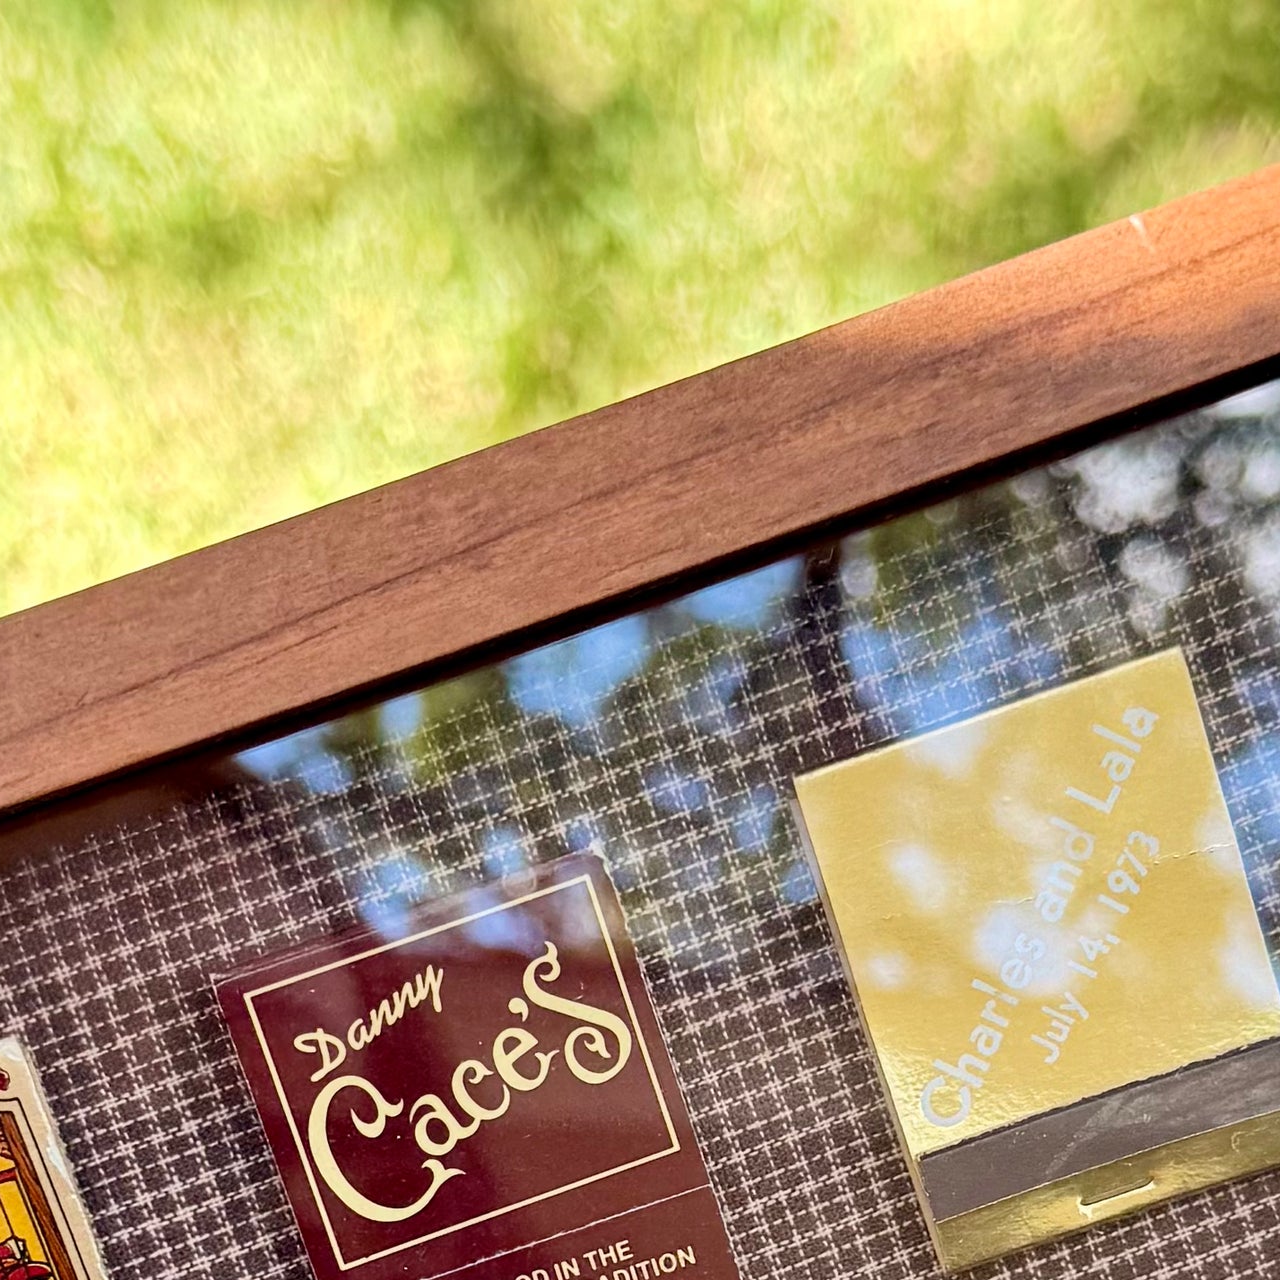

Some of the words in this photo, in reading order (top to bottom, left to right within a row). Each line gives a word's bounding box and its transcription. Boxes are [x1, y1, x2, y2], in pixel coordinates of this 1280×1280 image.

[920, 933, 1047, 1127] Charles
[1035, 816, 1095, 923] and
[1065, 706, 1159, 814] Lala
[1031, 992, 1089, 1064] July
[1068, 932, 1120, 978] 14,
[1099, 830, 1160, 914] 1973
[294, 965, 444, 1082] Danny
[583, 1239, 634, 1271] THE
